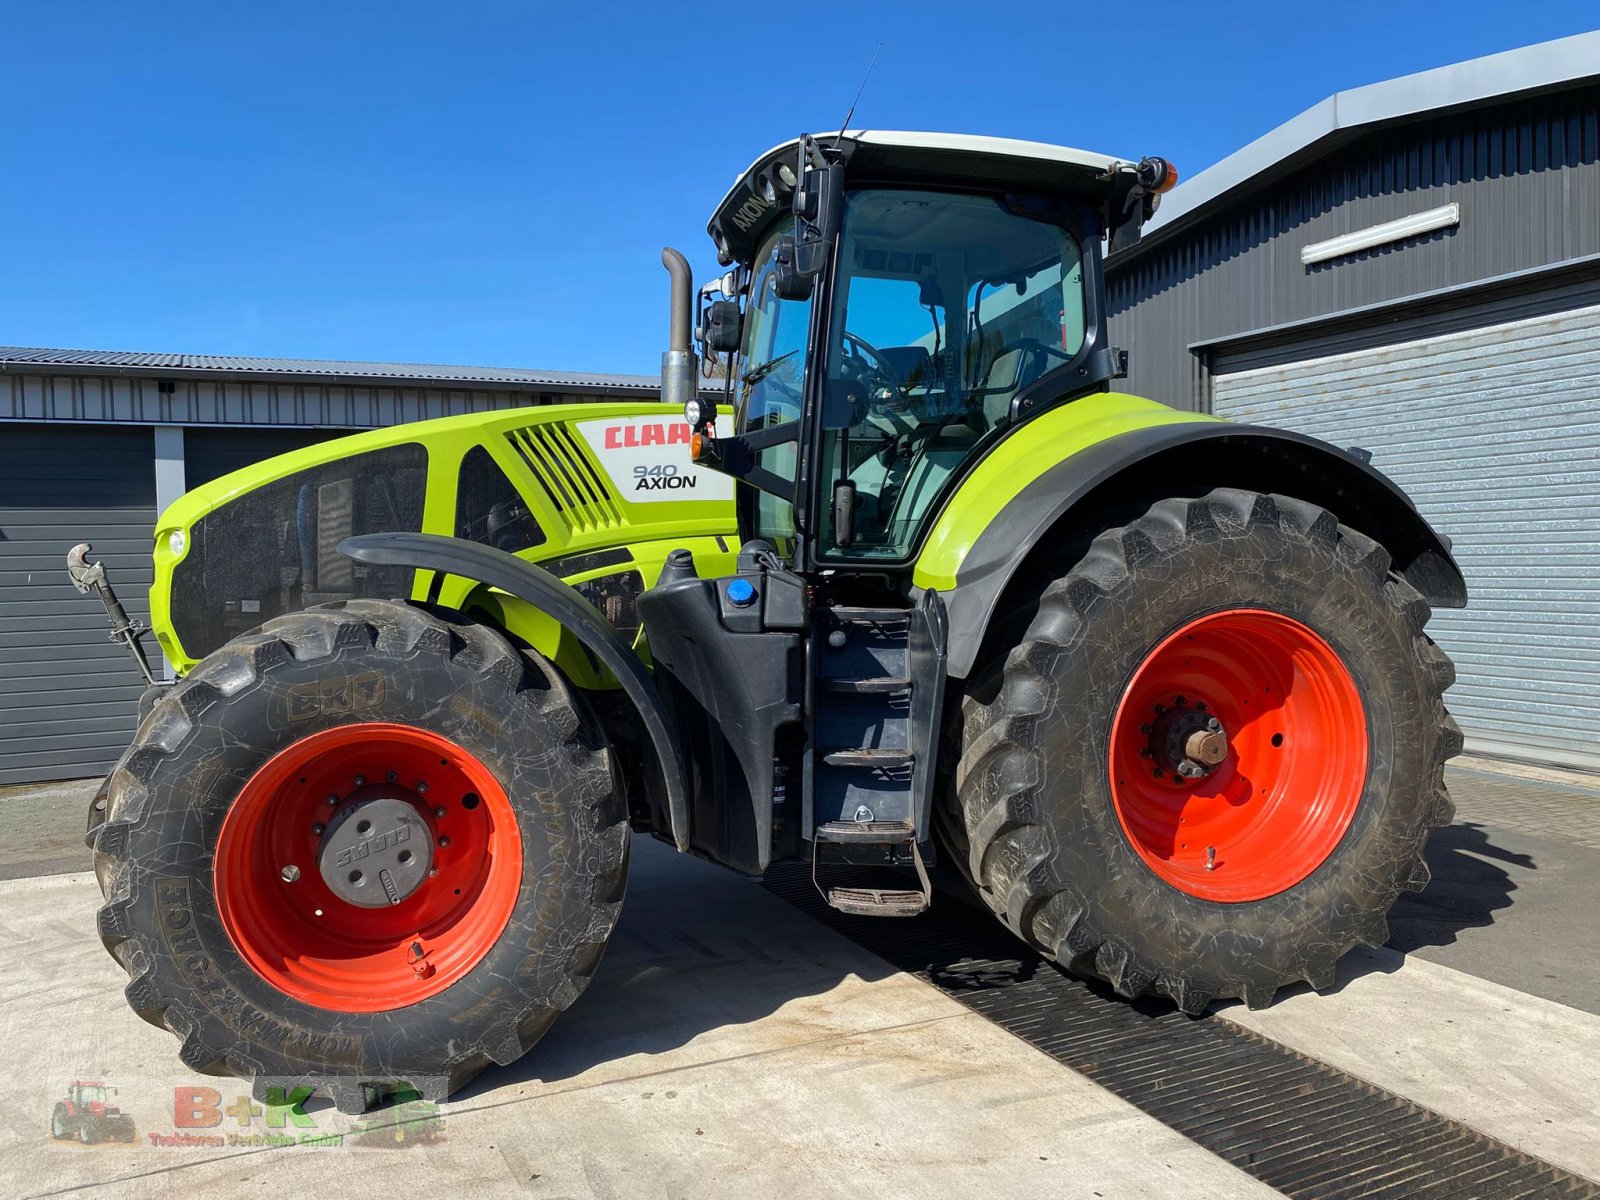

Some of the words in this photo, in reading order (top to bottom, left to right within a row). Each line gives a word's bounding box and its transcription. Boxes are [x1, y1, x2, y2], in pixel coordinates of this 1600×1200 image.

[731, 193, 770, 233] AXION
[633, 464, 677, 478] 940
[635, 475, 697, 491] AXION
[336, 824, 410, 868] CLAAS
